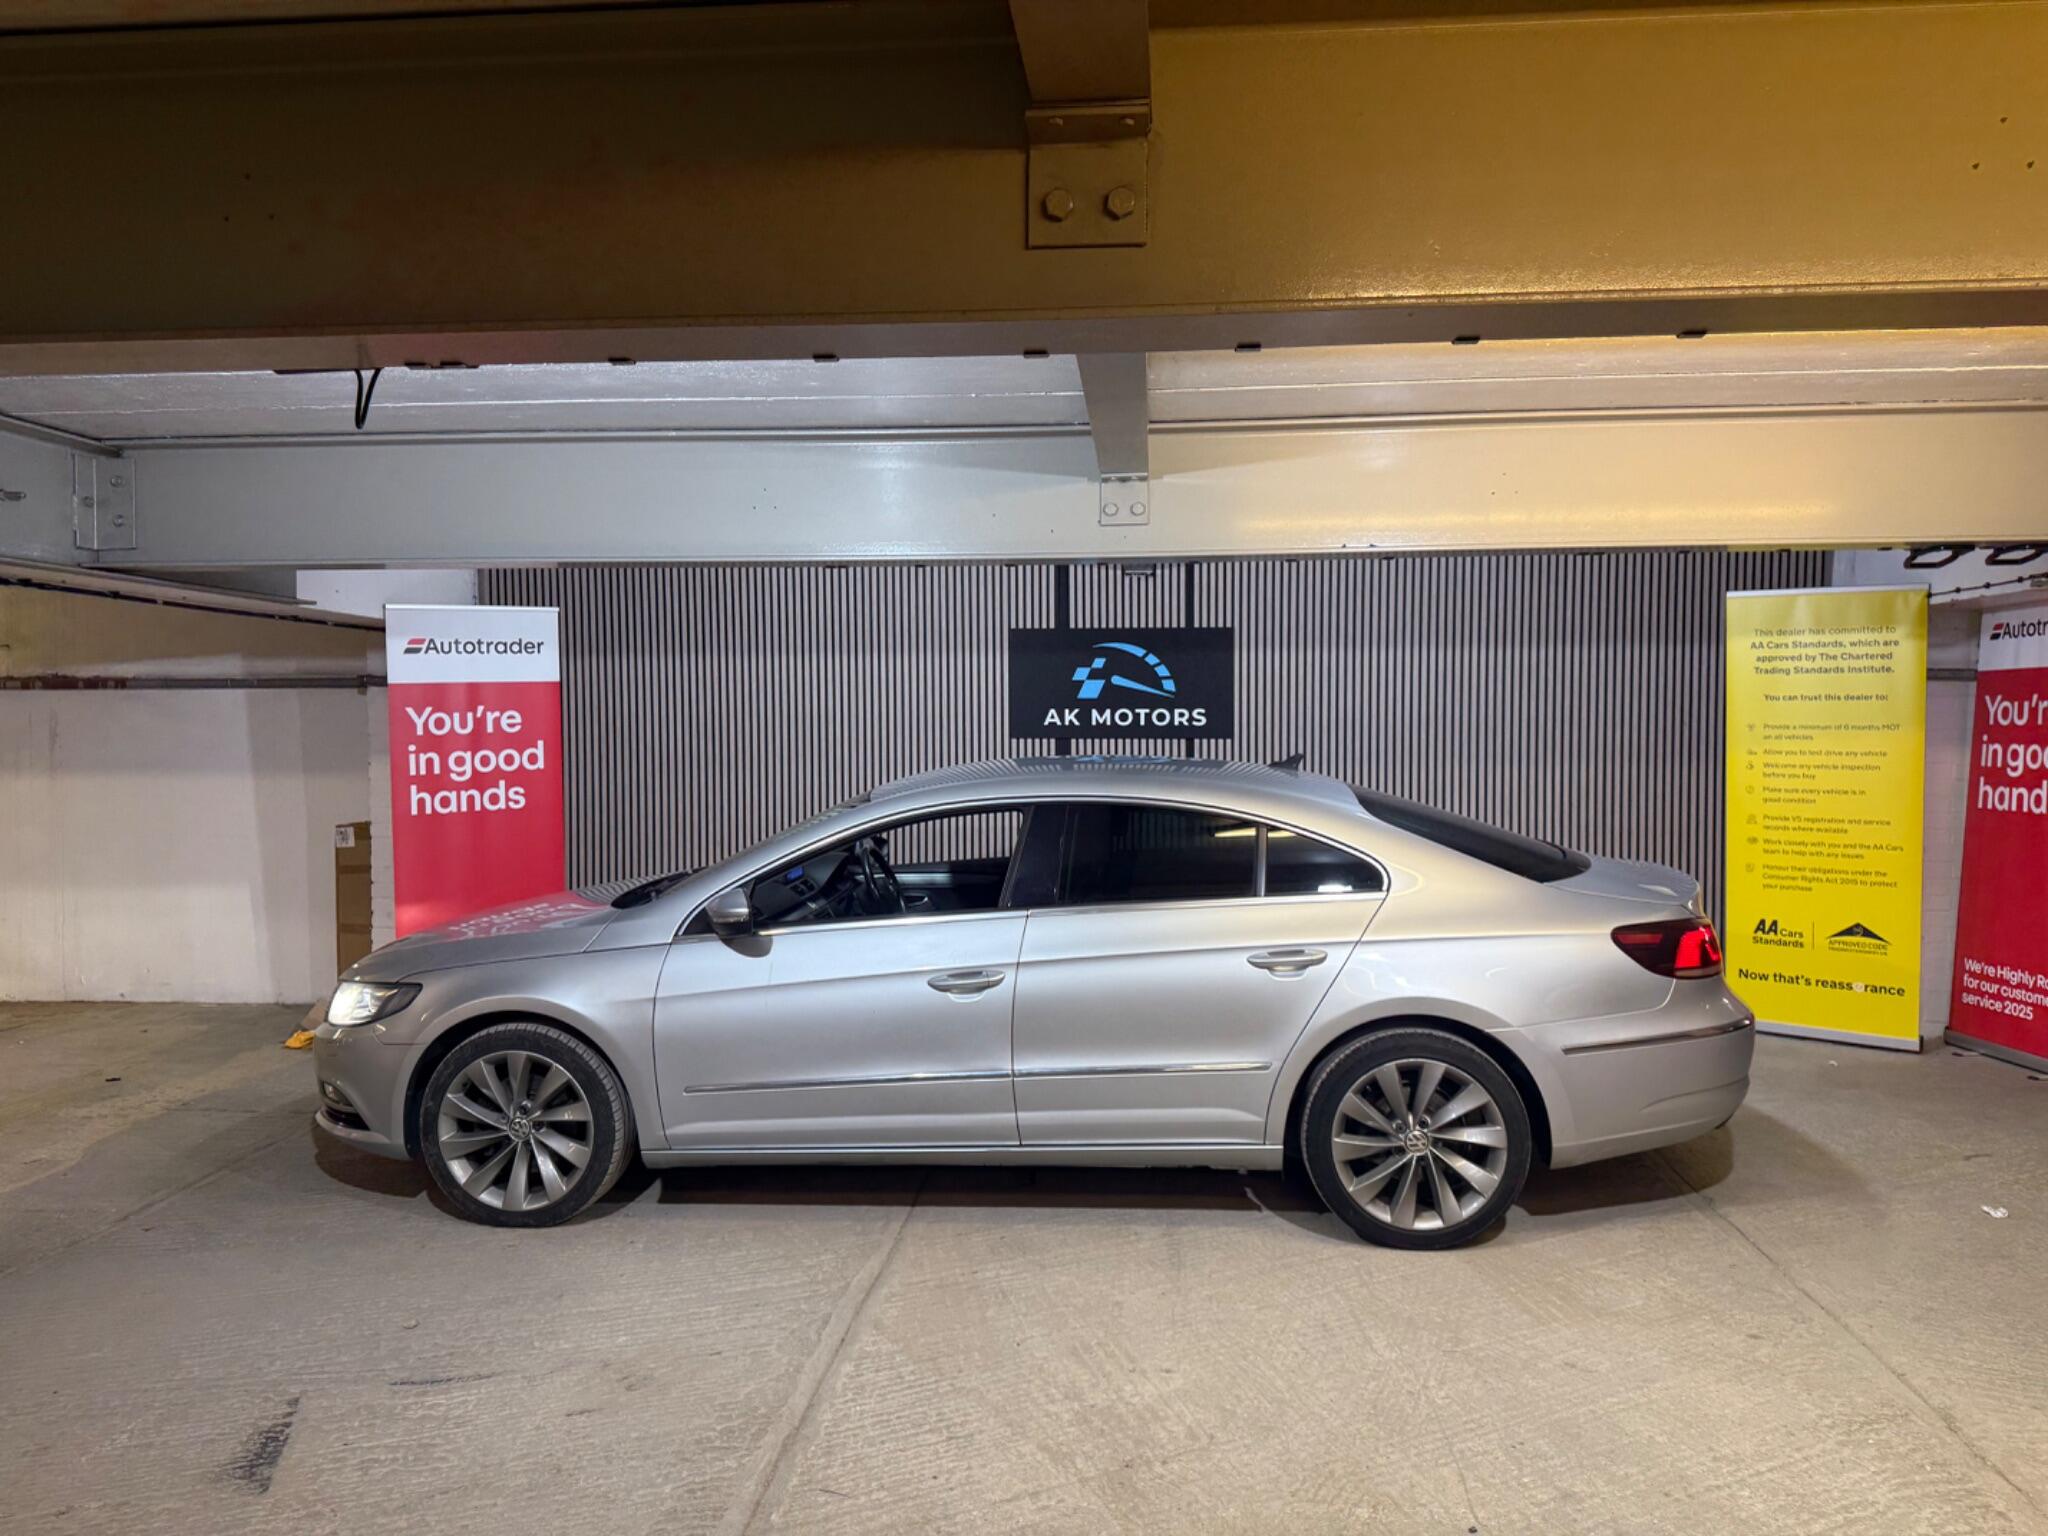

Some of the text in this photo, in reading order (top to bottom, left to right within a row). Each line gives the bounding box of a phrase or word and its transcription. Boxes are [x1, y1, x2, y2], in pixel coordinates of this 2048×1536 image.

[1754, 629, 1774, 637] This
[1776, 628, 1805, 636] dealer
[1828, 626, 1883, 635] committed
[1885, 626, 1896, 634] to
[424, 638, 544, 655] Autotrader
[1792, 640, 1846, 648] Standards,
[1756, 652, 1893, 663] approved by The Chartered
[1754, 665, 1895, 676] Trading Standards Institute.
[405, 705, 522, 736] You're
[1043, 708, 1207, 726] AK MOTORS
[1981, 734, 2002, 768] in
[408, 740, 544, 782] in good
[410, 780, 526, 816] hands
[1804, 816, 1845, 824] registration
[1784, 840, 1808, 848] closely
[1808, 867, 1849, 876] obligations
[1763, 873, 1799, 881] Consumer
[1801, 875, 1823, 884] Rights
[1870, 880, 1898, 888] protect
[1780, 884, 1812, 892] purchase
[1754, 918, 1804, 938] AA Cars
[1752, 936, 1804, 949] Standards
[1828, 940, 1887, 950] APPROVED CODE
[1738, 968, 1770, 981] Now
[1773, 972, 1811, 986] that's
[1964, 957, 1996, 977] We're
[1997, 965, 2035, 988] Highly
[1963, 973, 1979, 989] for
[1980, 981, 1999, 994] our
[1962, 992, 2033, 1020] service 2025
